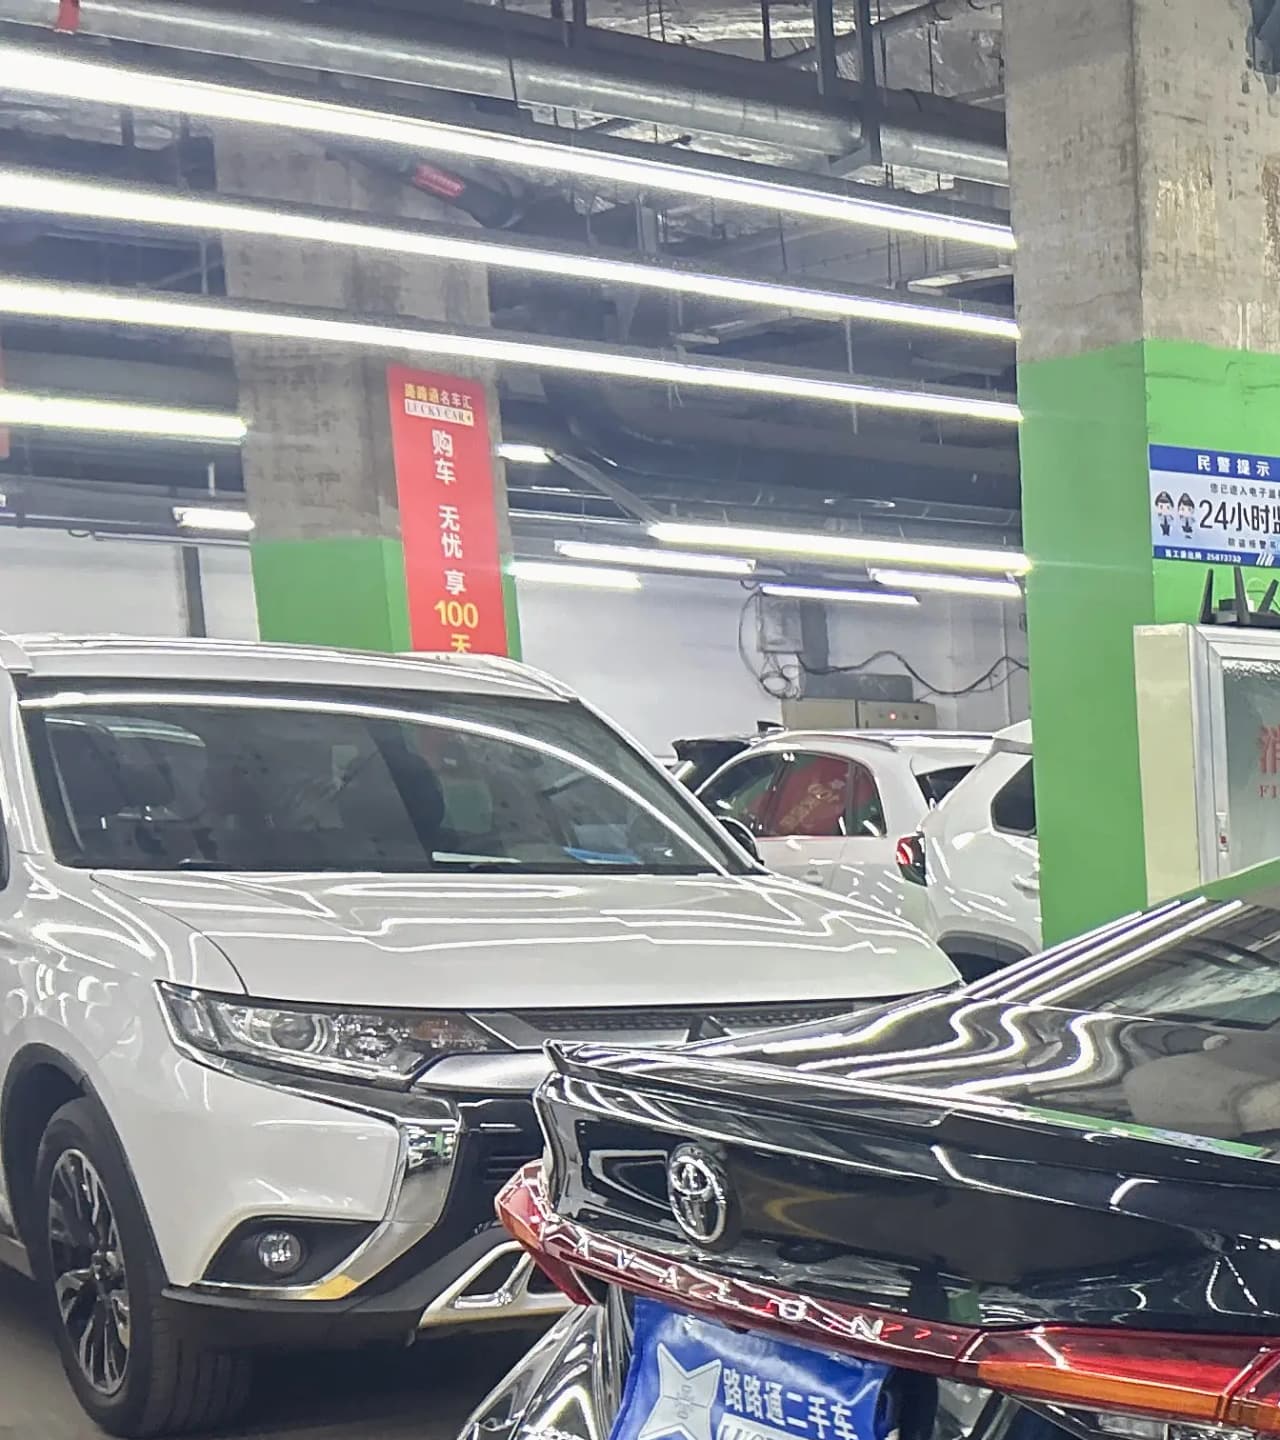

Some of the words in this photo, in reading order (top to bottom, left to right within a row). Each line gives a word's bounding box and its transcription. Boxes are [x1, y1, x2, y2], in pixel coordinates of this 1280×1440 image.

[431, 428, 457, 486] 购车
[1197, 454, 1271, 477] 民警提示
[438, 504, 463, 559] 无忧
[444, 569, 466, 596] 享
[433, 600, 479, 629] 100
